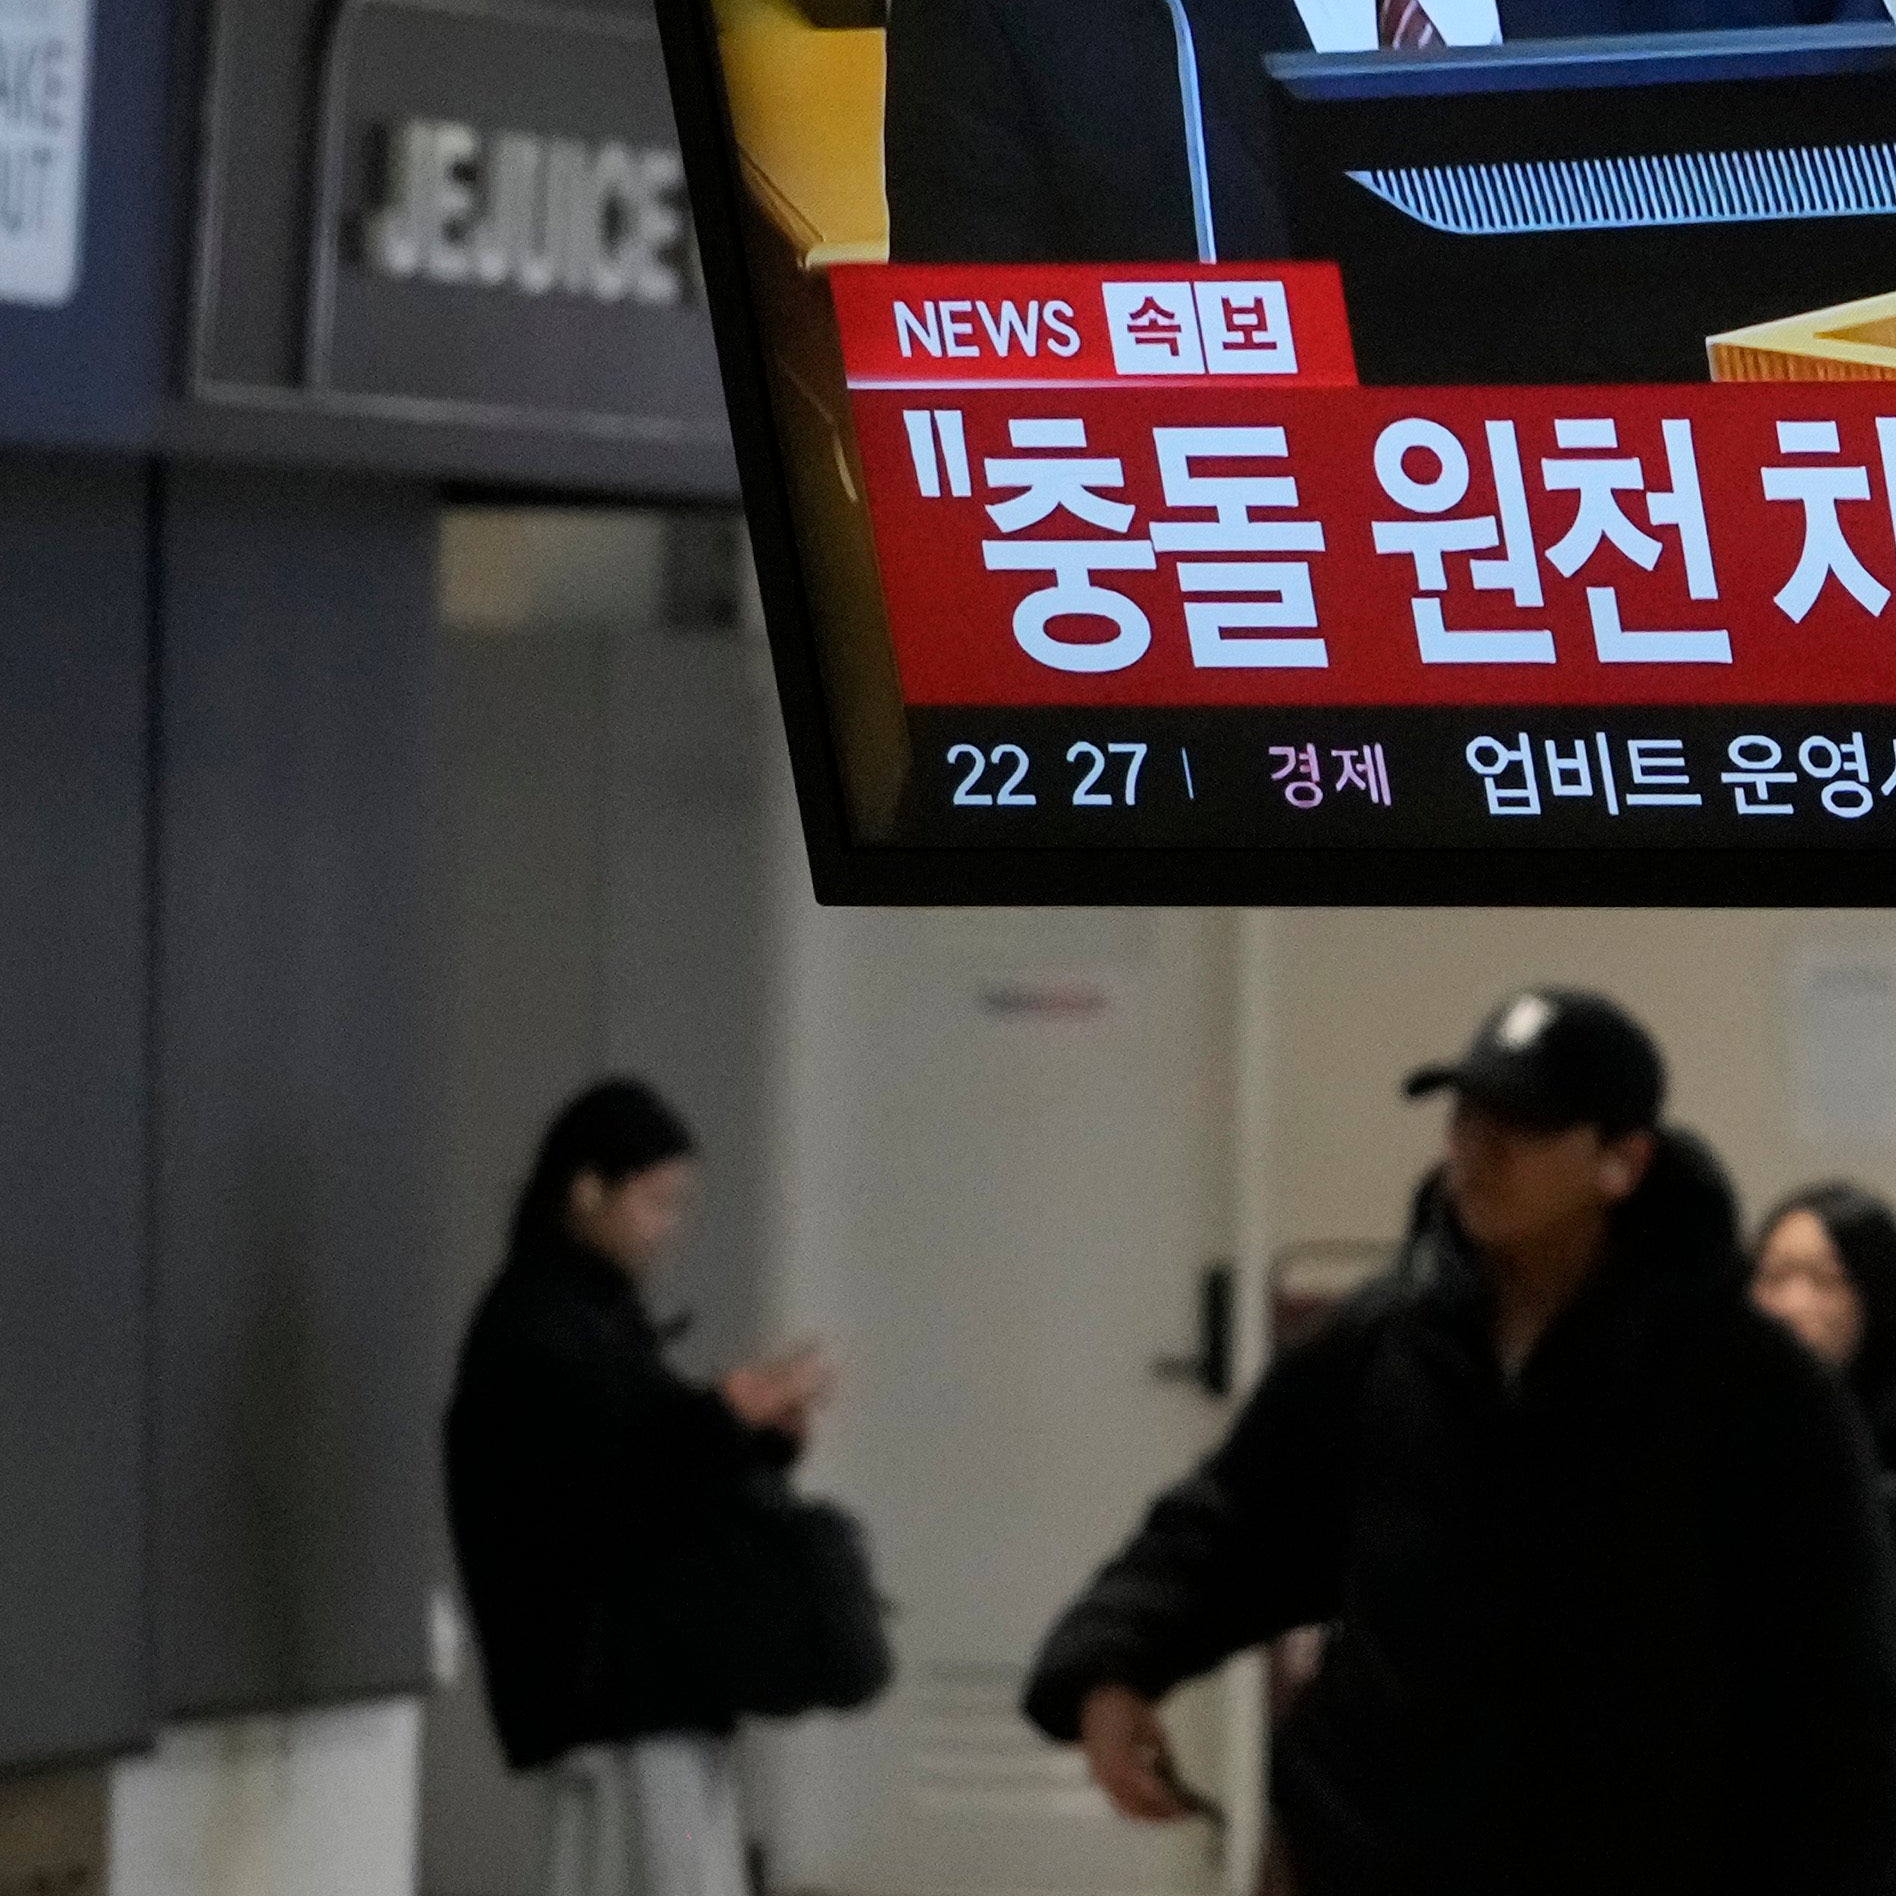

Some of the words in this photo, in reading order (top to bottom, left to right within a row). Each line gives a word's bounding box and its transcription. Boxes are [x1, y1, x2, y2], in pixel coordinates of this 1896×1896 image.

[892, 299, 1082, 359] NEWS
[1126, 296, 1278, 358] 속보
[1370, 416, 1734, 665] 원천
[1267, 742, 1393, 810] 경제
[1464, 730, 1704, 817] 업비트
